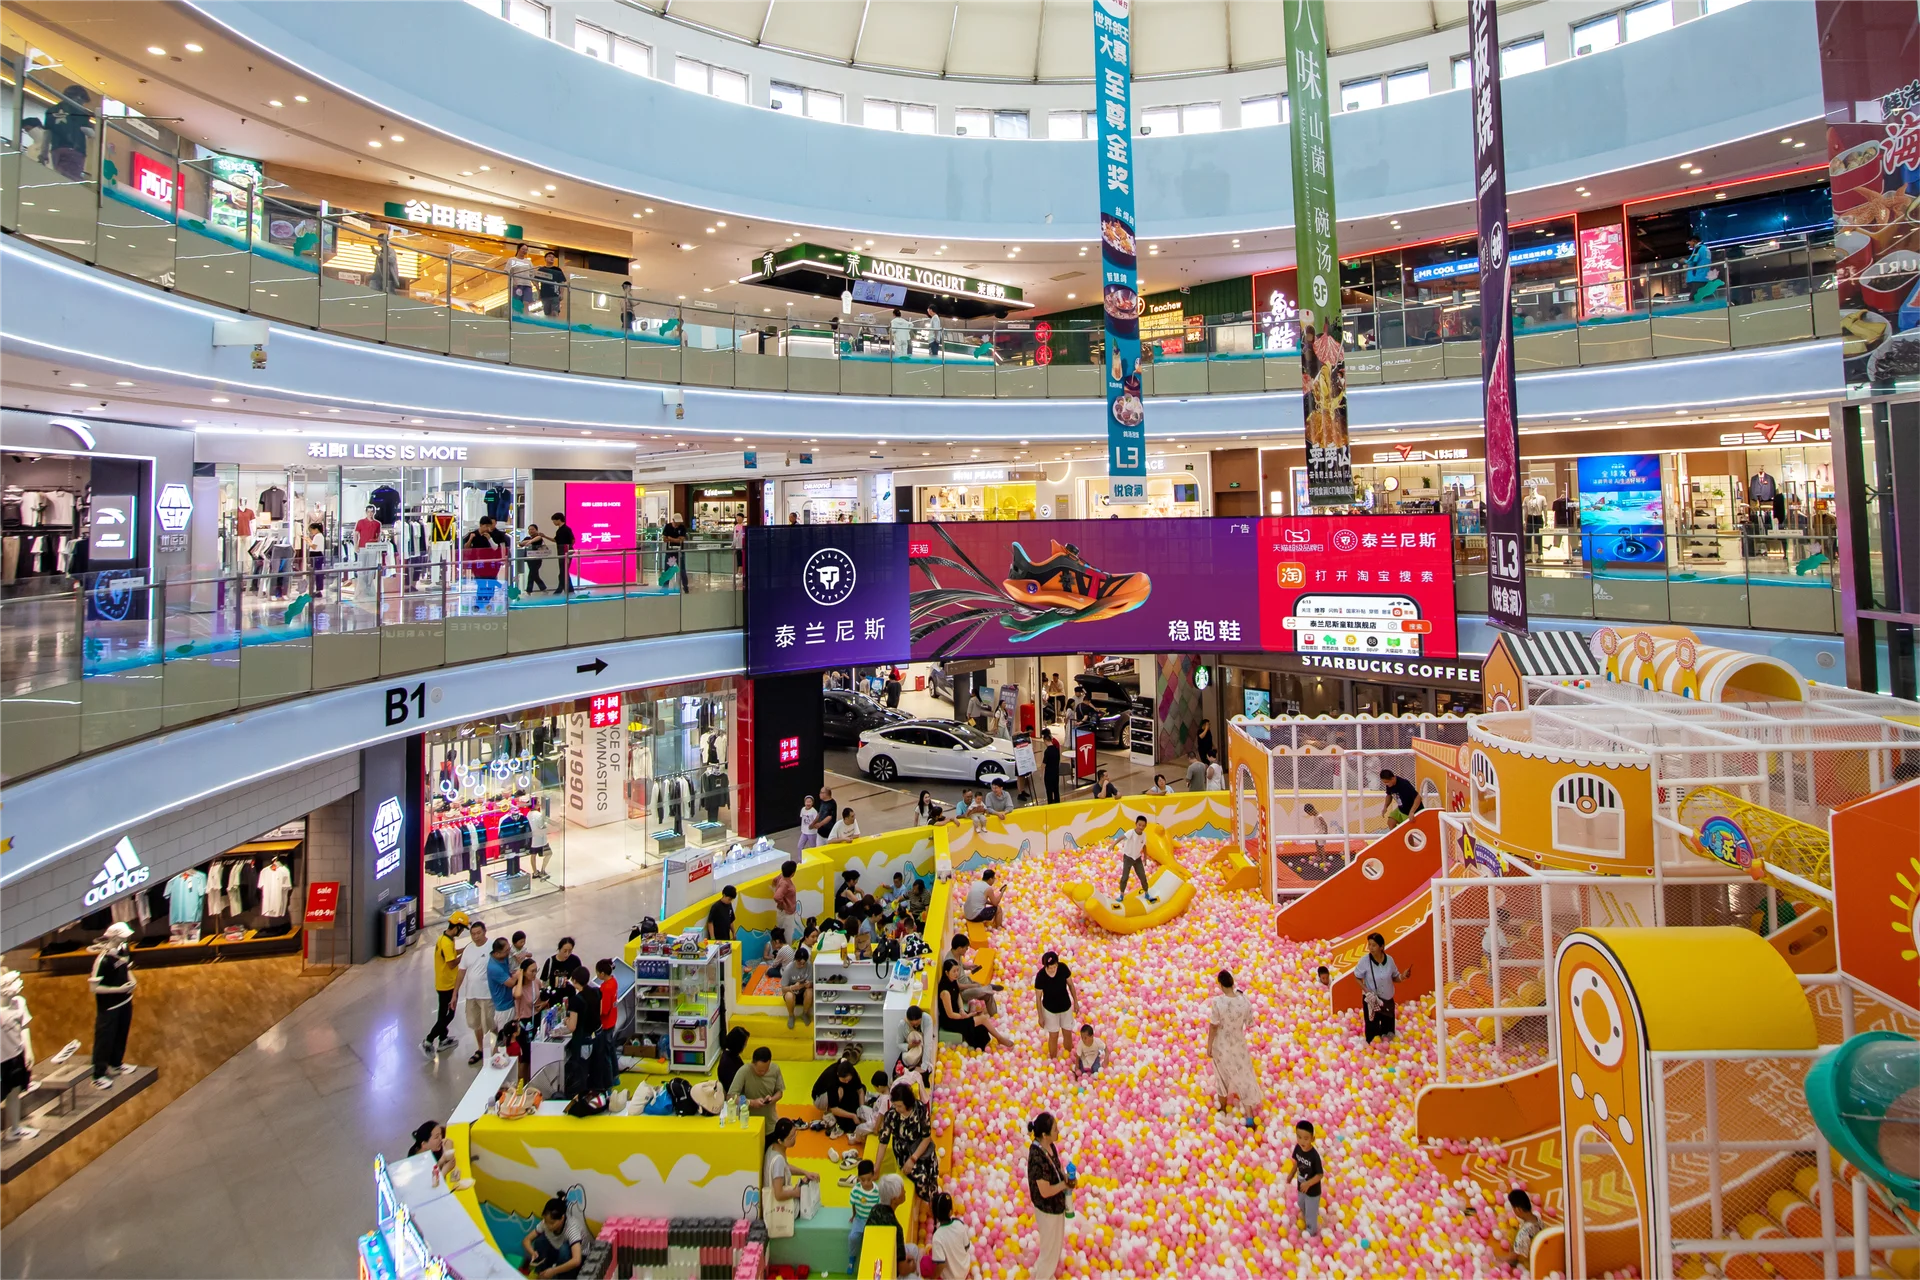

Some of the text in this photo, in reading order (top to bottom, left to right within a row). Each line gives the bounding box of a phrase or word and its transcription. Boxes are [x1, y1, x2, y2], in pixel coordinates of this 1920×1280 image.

[1094, 10, 1129, 42] 世界鸽王
[1099, 34, 1127, 66] 大赛
[1104, 67, 1129, 195] 至尊金奖
[1309, 112, 1332, 273] 山菌一碗汤
[404, 198, 508, 237] 谷田稻香
[871, 259, 911, 280] MORE
[915, 269, 967, 292] YOGURT
[1419, 269, 1433, 278] MR
[1433, 265, 1455, 276] COOL
[1312, 279, 1328, 302] 3F
[1149, 301, 1182, 313] Teochew
[353, 443, 396, 459] LESS
[400, 445, 415, 460] IS
[1115, 446, 1139, 469] L3
[953, 469, 1004, 481] MINI PEACE
[1230, 523, 1250, 534] 广告
[581, 532, 621, 543] 买一送一
[1361, 532, 1437, 549] 泰兰尼斯
[910, 543, 930, 555] 天猫
[1273, 544, 1324, 552] 天猫超级品牌日
[1498, 538, 1519, 579] L3
[1281, 567, 1303, 584] 淘
[1315, 570, 1434, 583] 打开淘宝搜索
[774, 617, 886, 648] 泰兰尼斯
[1168, 619, 1242, 643] 稳跑鞋
[1310, 620, 1377, 630] 泰兰尼斯童鞋旗舰店
[1302, 655, 1480, 683] STARBUCKS COFFEE
[385, 682, 426, 728] B1
[593, 694, 619, 710] 中國
[593, 709, 619, 724] 李寧
[781, 738, 798, 750] 中國
[610, 752, 621, 773] OF
[84, 865, 150, 907] adidas
[316, 886, 332, 895] sale
